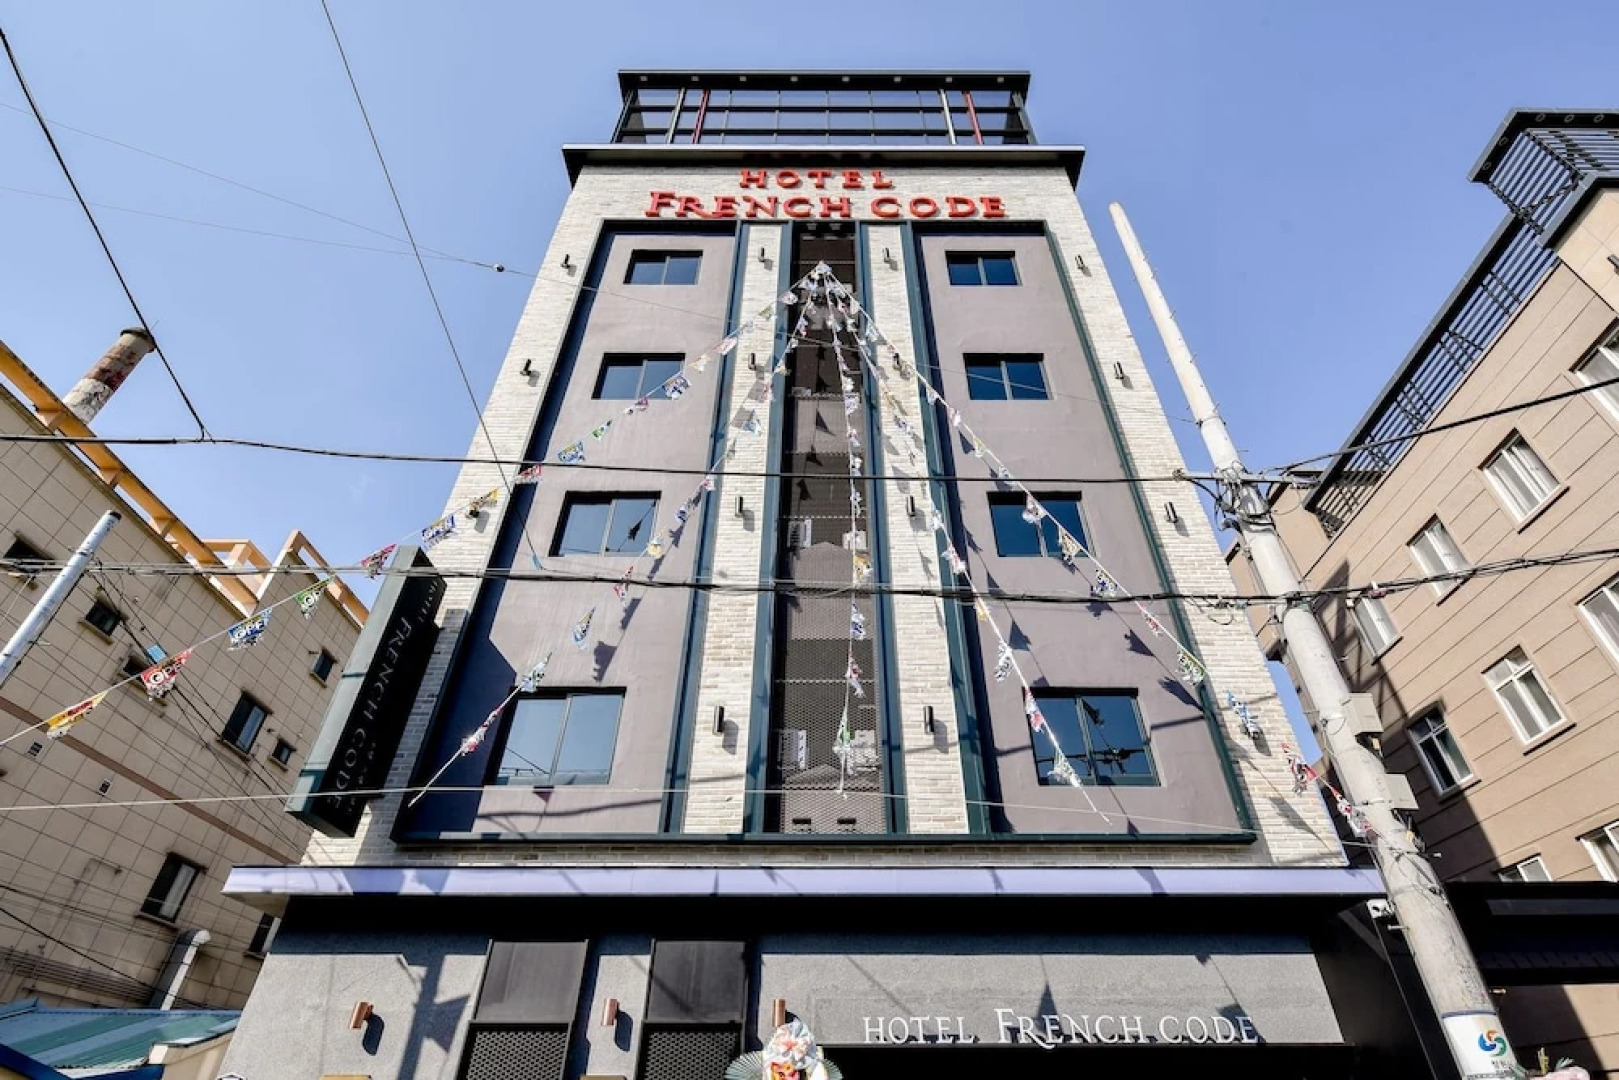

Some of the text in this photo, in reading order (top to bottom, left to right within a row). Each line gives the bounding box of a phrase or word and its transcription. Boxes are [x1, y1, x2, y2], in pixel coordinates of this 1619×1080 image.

[739, 169, 893, 189] HOTEL
[645, 191, 1006, 219] FRENCH CODE
[363, 616, 412, 721] FRENCH
[862, 1008, 1259, 1050] HOTEL FRENCH CODE
